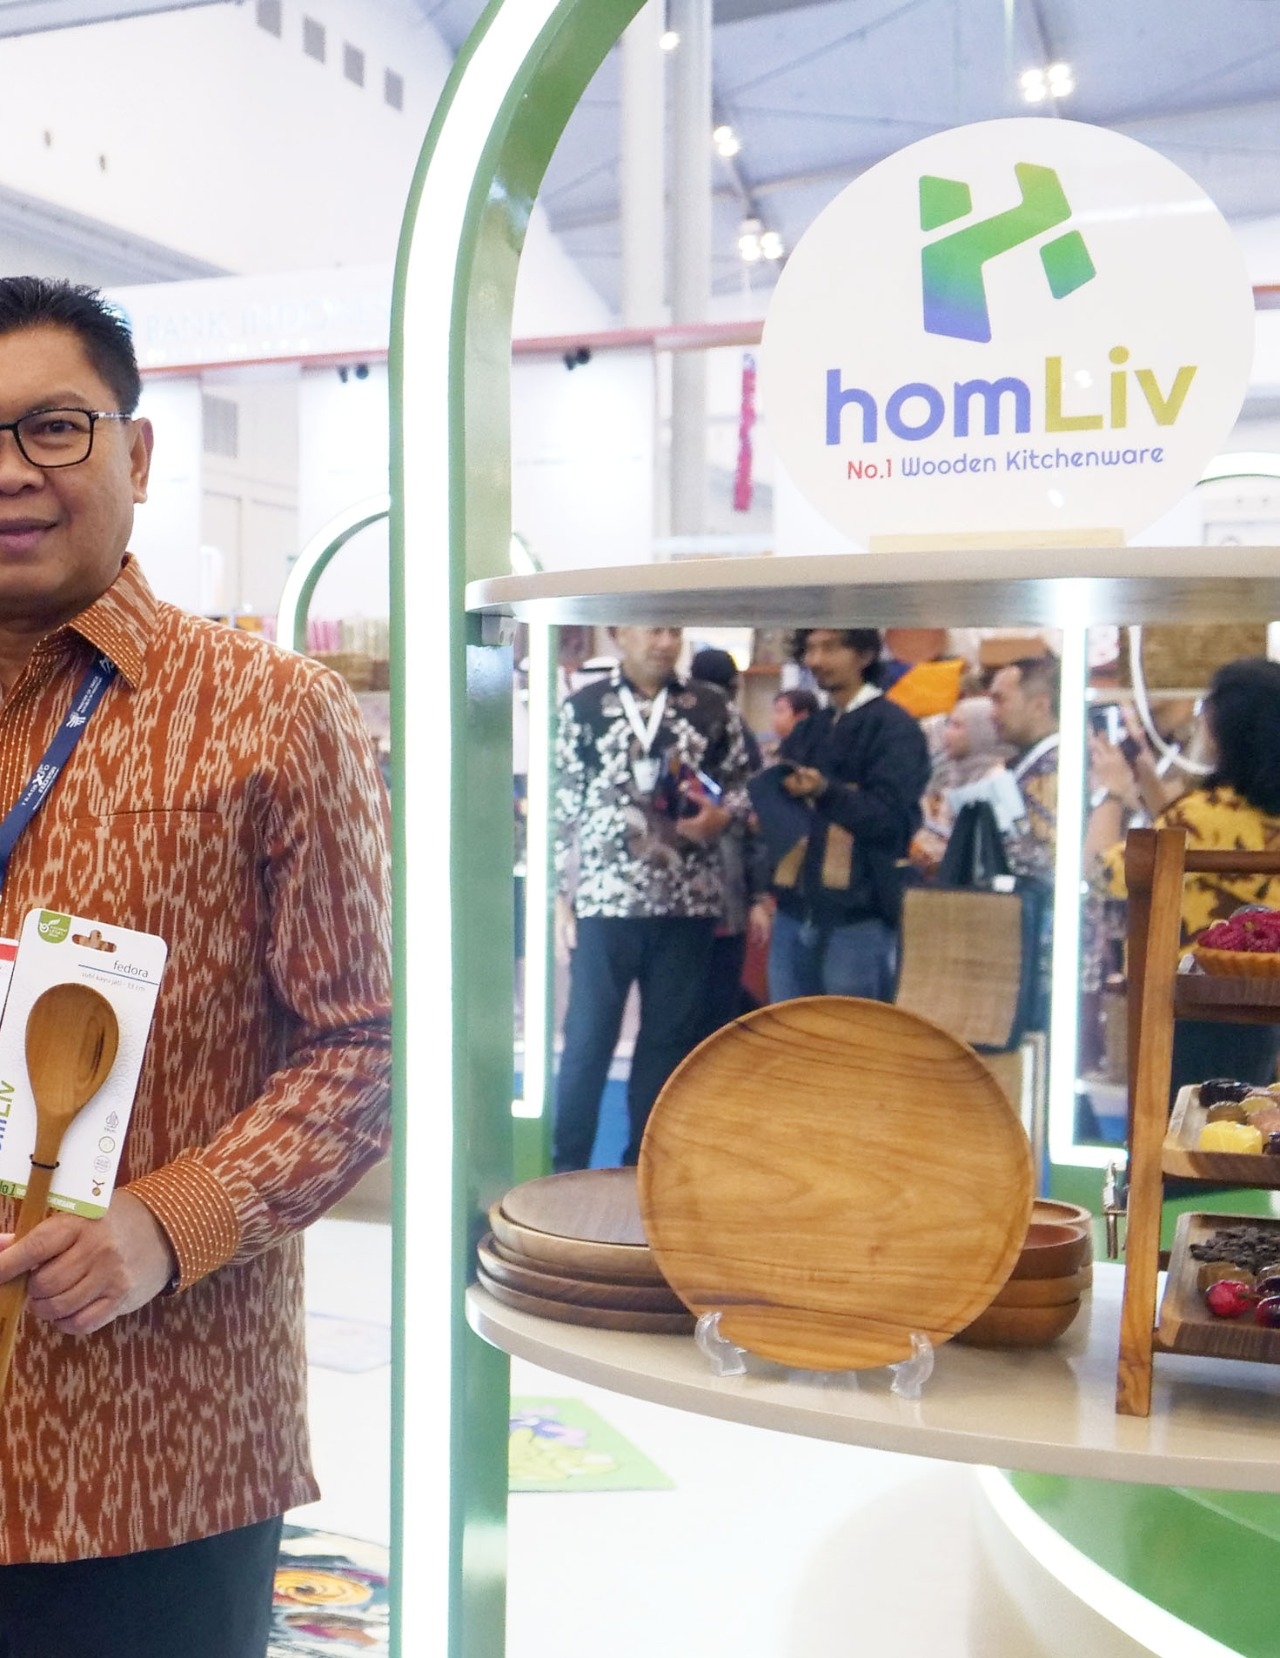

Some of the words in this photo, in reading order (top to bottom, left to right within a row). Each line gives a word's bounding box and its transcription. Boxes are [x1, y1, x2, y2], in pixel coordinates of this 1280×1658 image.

[826, 346, 1198, 445] homLiv
[847, 459, 893, 480] No.1
[901, 453, 996, 477] Wooden
[1006, 447, 1164, 472] Kitchenware
[113, 960, 149, 978] fedora
